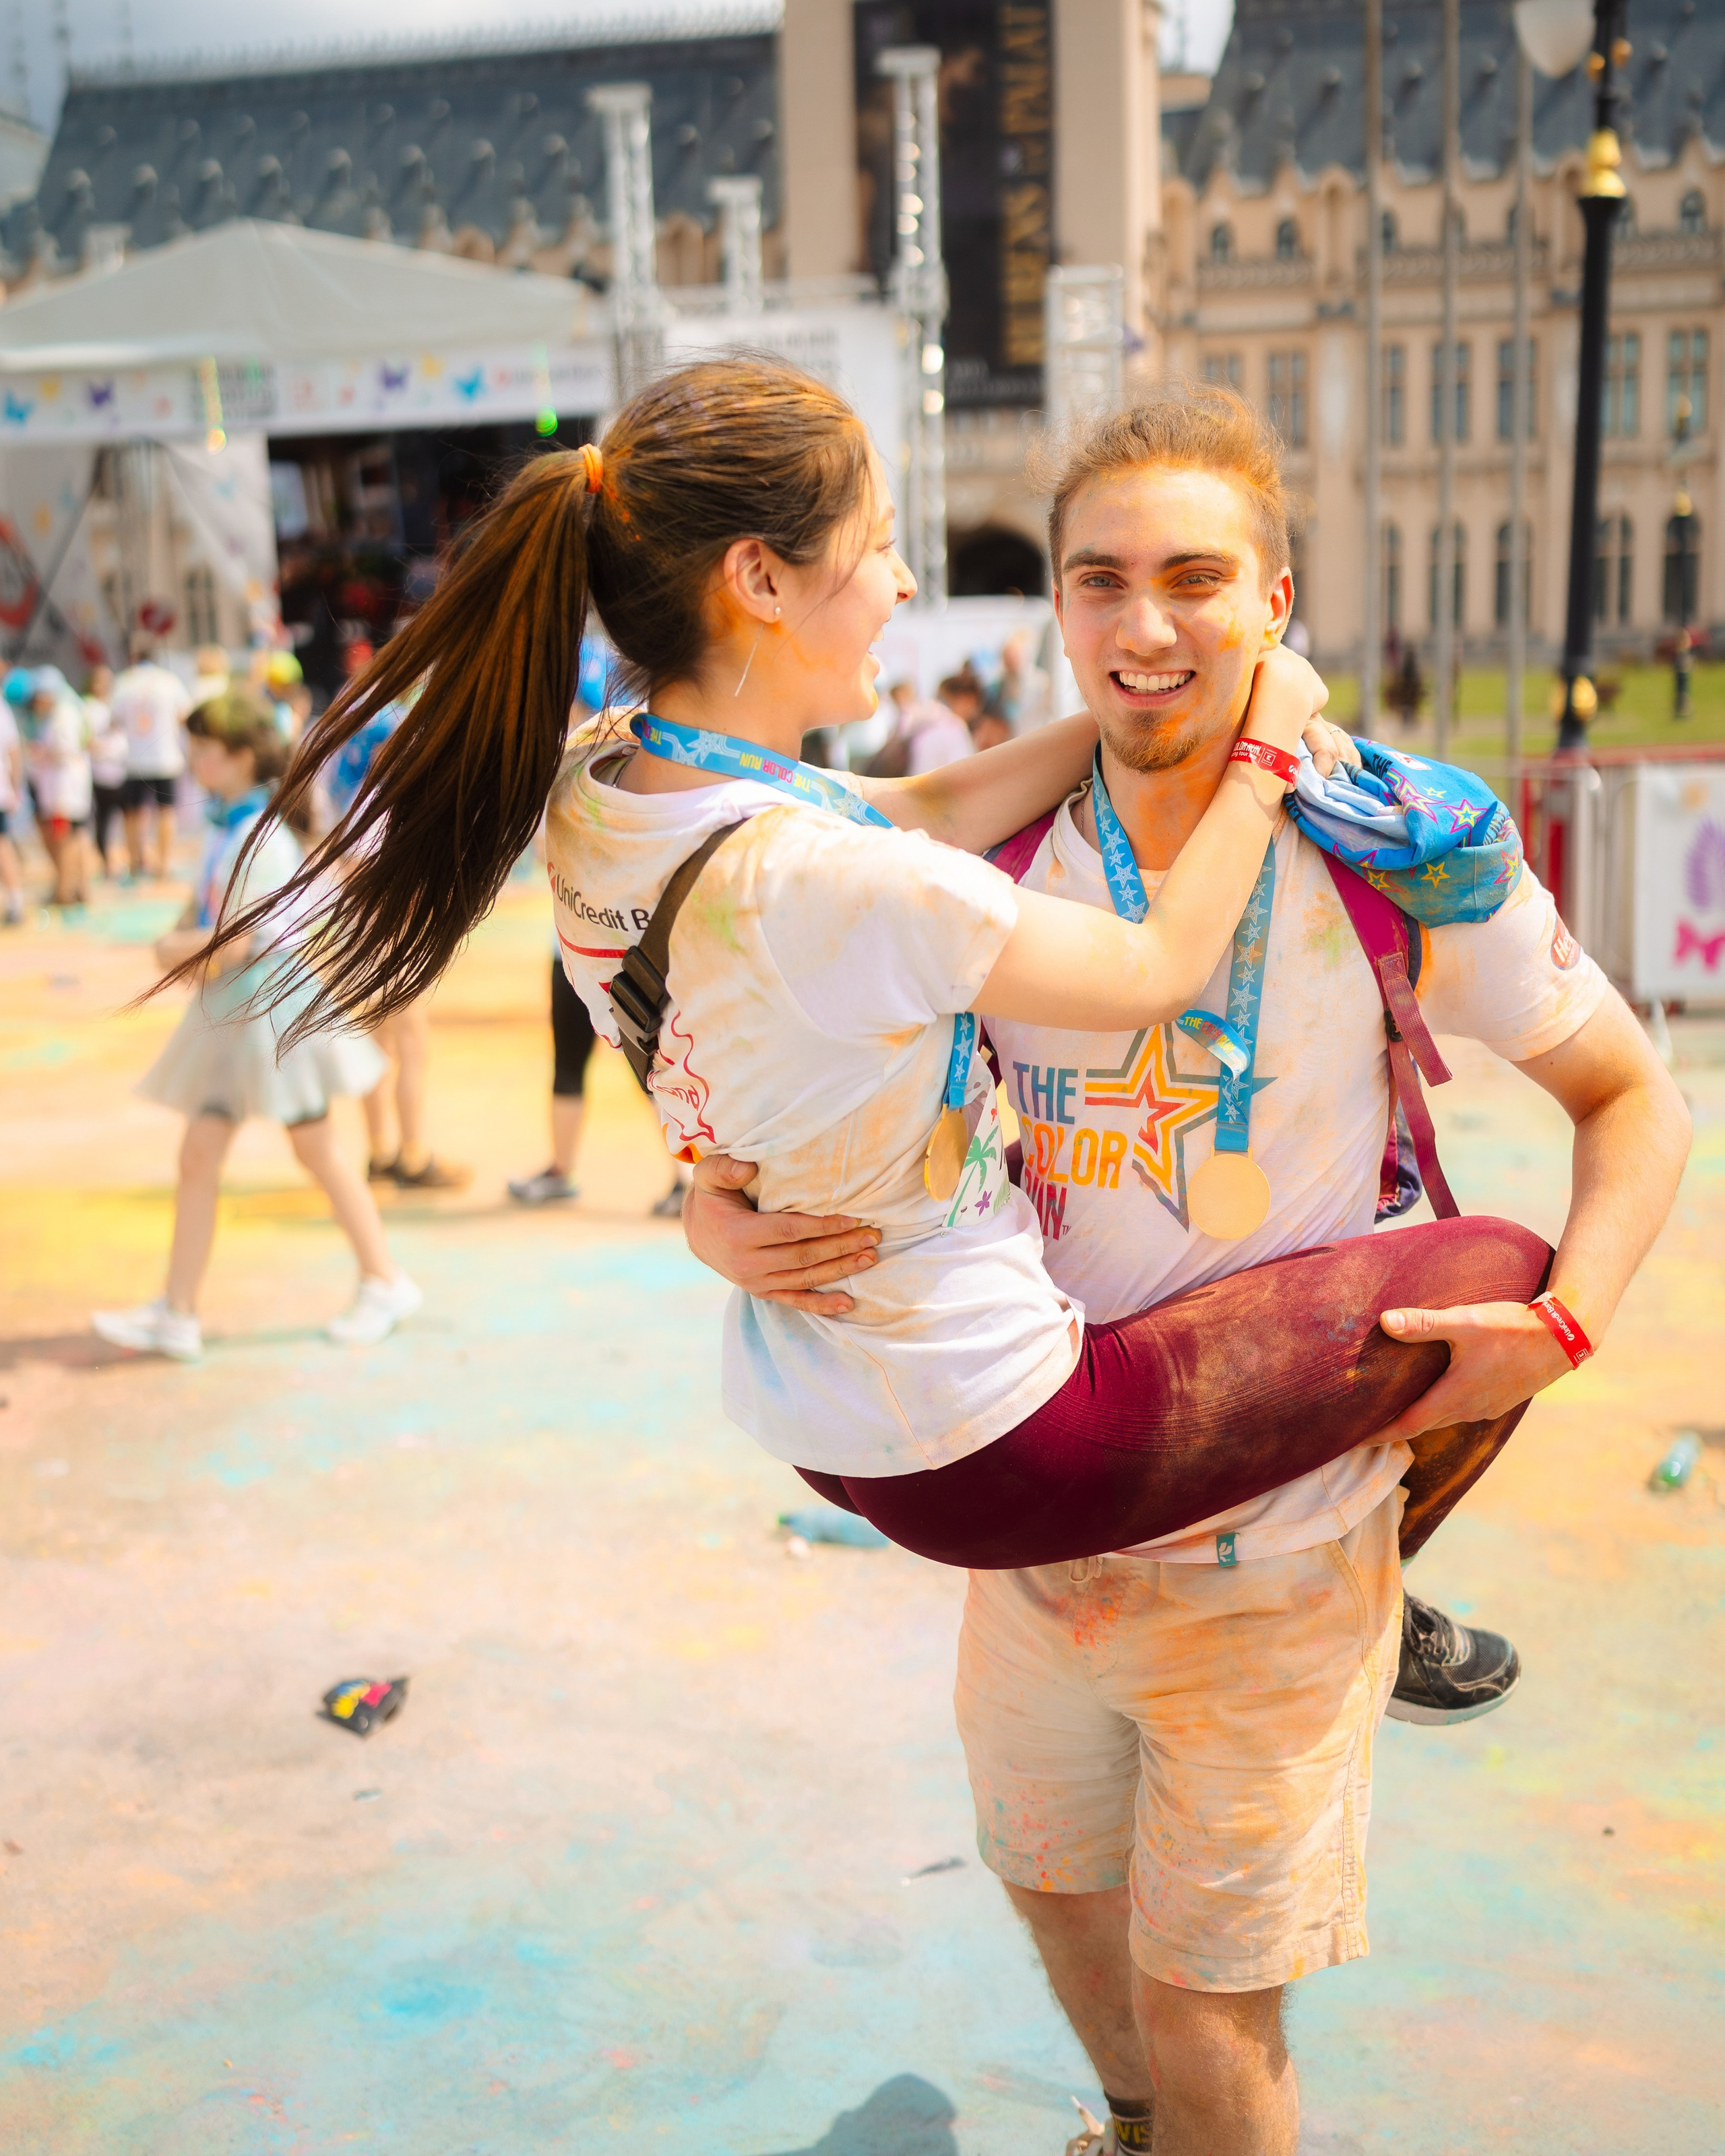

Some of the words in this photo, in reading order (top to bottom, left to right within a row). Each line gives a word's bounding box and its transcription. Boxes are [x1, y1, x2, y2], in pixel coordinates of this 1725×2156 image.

[740, 752, 763, 769] RUN
[763, 759, 793, 784] COLOR
[793, 773, 811, 792] THE
[556, 874, 629, 932] UniCredit
[1185, 1017, 1203, 1029] THE
[1216, 1034, 1236, 1053] RUN
[1013, 1060, 1078, 1124] THE
[1021, 1115, 1128, 1189] COLOR
[1550, 1310, 1571, 1336] UniCredit
